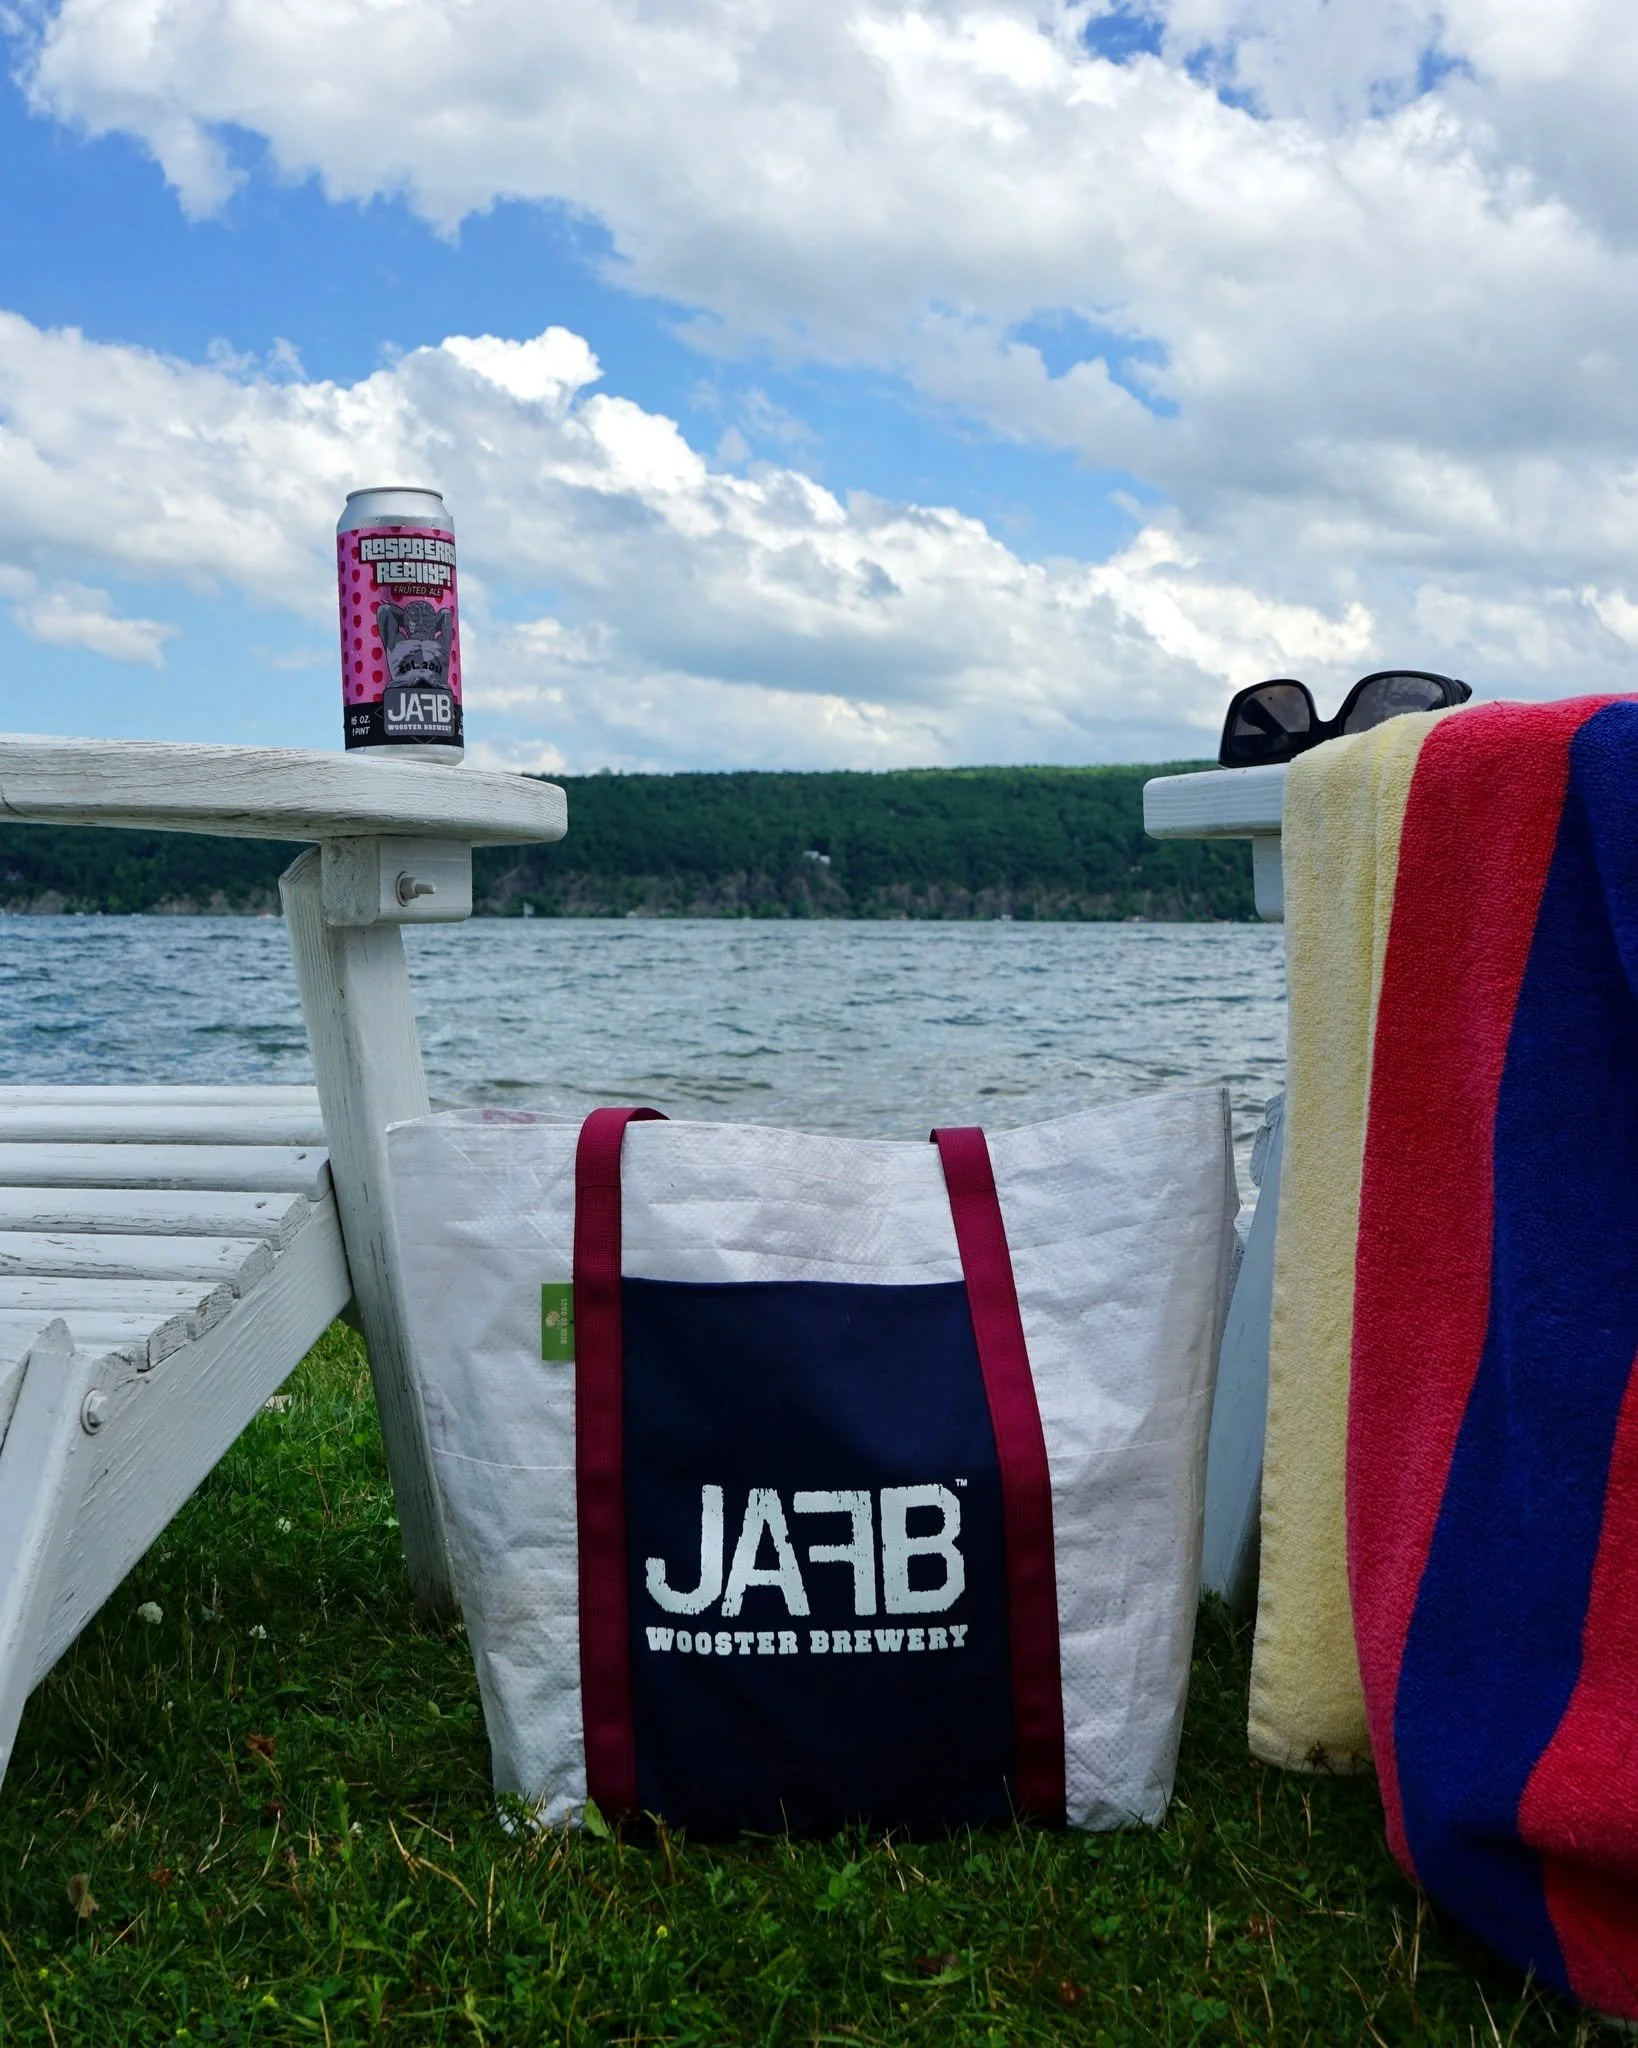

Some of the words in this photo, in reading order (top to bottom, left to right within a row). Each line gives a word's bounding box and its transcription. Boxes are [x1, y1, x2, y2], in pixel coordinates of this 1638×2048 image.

[394, 585, 427, 595] FRUITED
[429, 587, 442, 597] ALE
[359, 714, 371, 724] OZ.
[387, 693, 452, 724] JAFB
[355, 726, 371, 736] PINT
[645, 1484, 966, 1617] JAFB
[645, 1626, 799, 1656] WOOSTER
[810, 1624, 969, 1654] BREWERY
